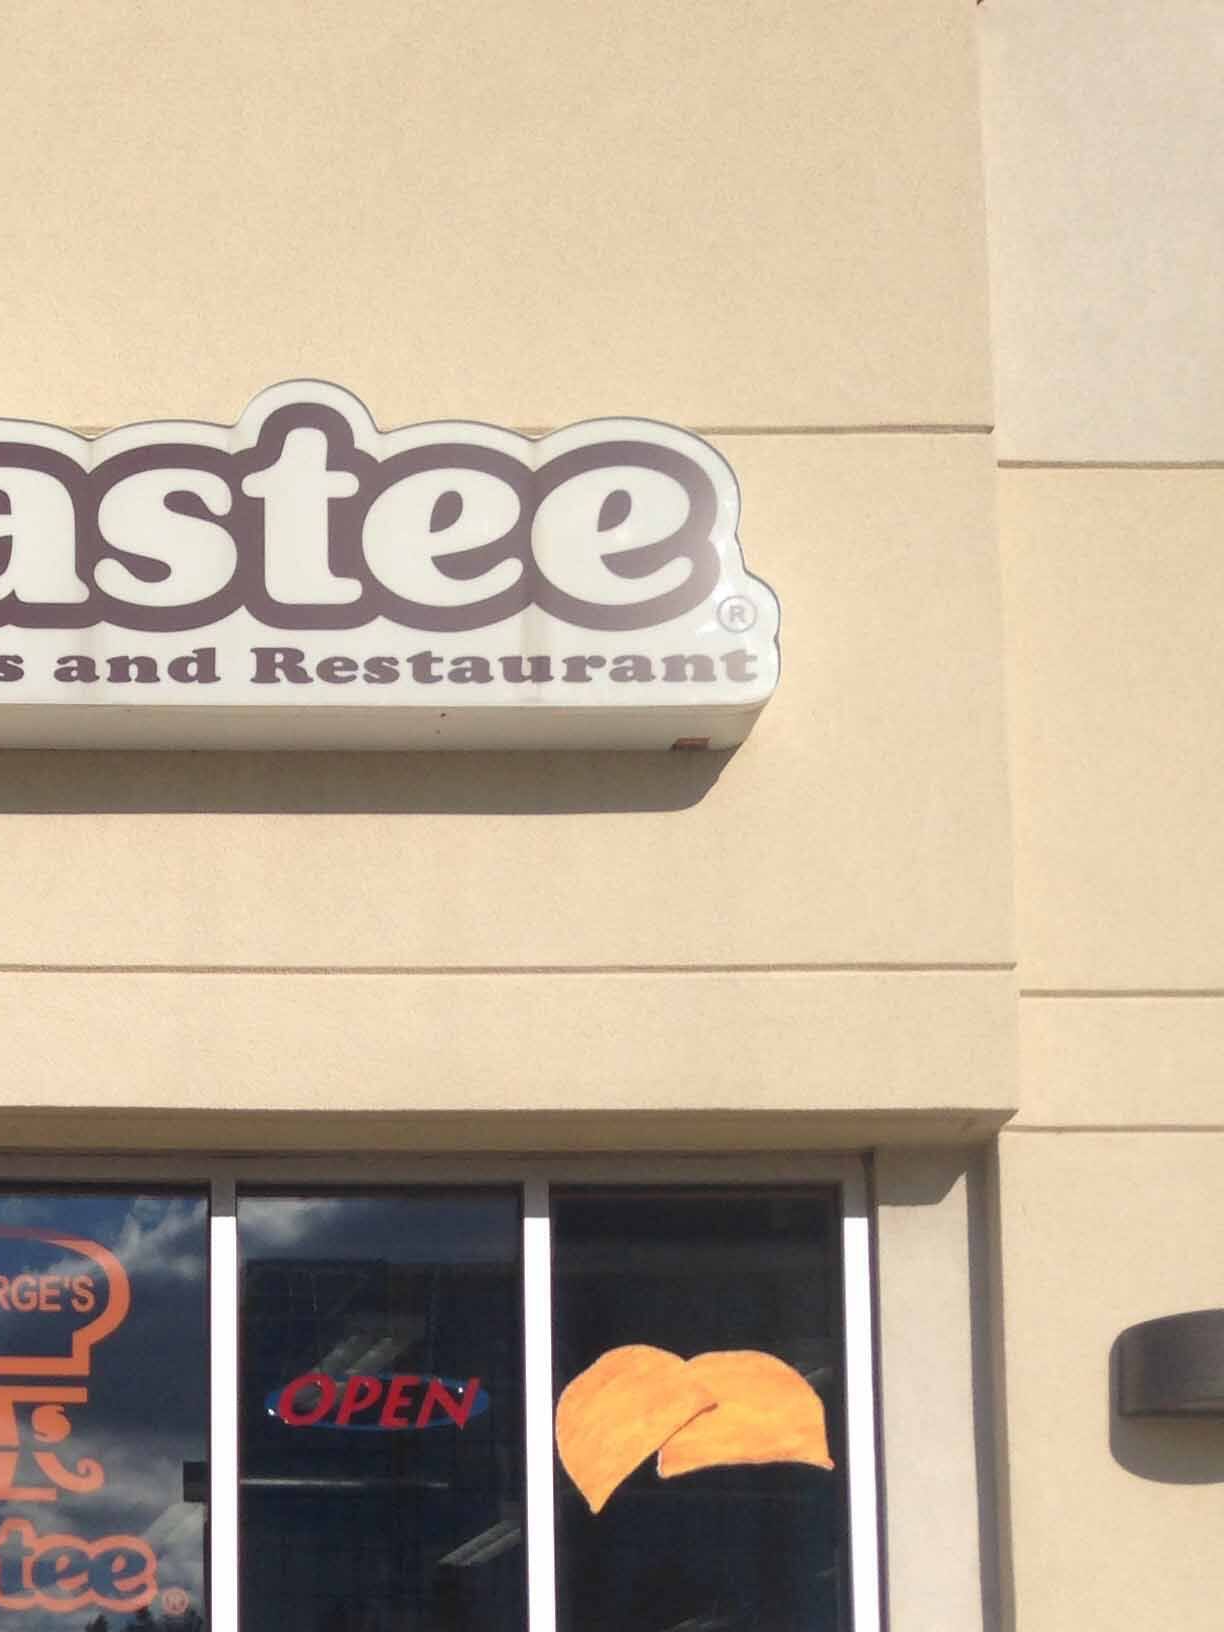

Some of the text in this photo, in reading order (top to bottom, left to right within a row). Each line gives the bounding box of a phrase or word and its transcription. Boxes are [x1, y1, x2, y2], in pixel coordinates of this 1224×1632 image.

[53, 646, 218, 685] and
[250, 646, 759, 686] Restaurant
[279, 1371, 481, 1430] OPEN
